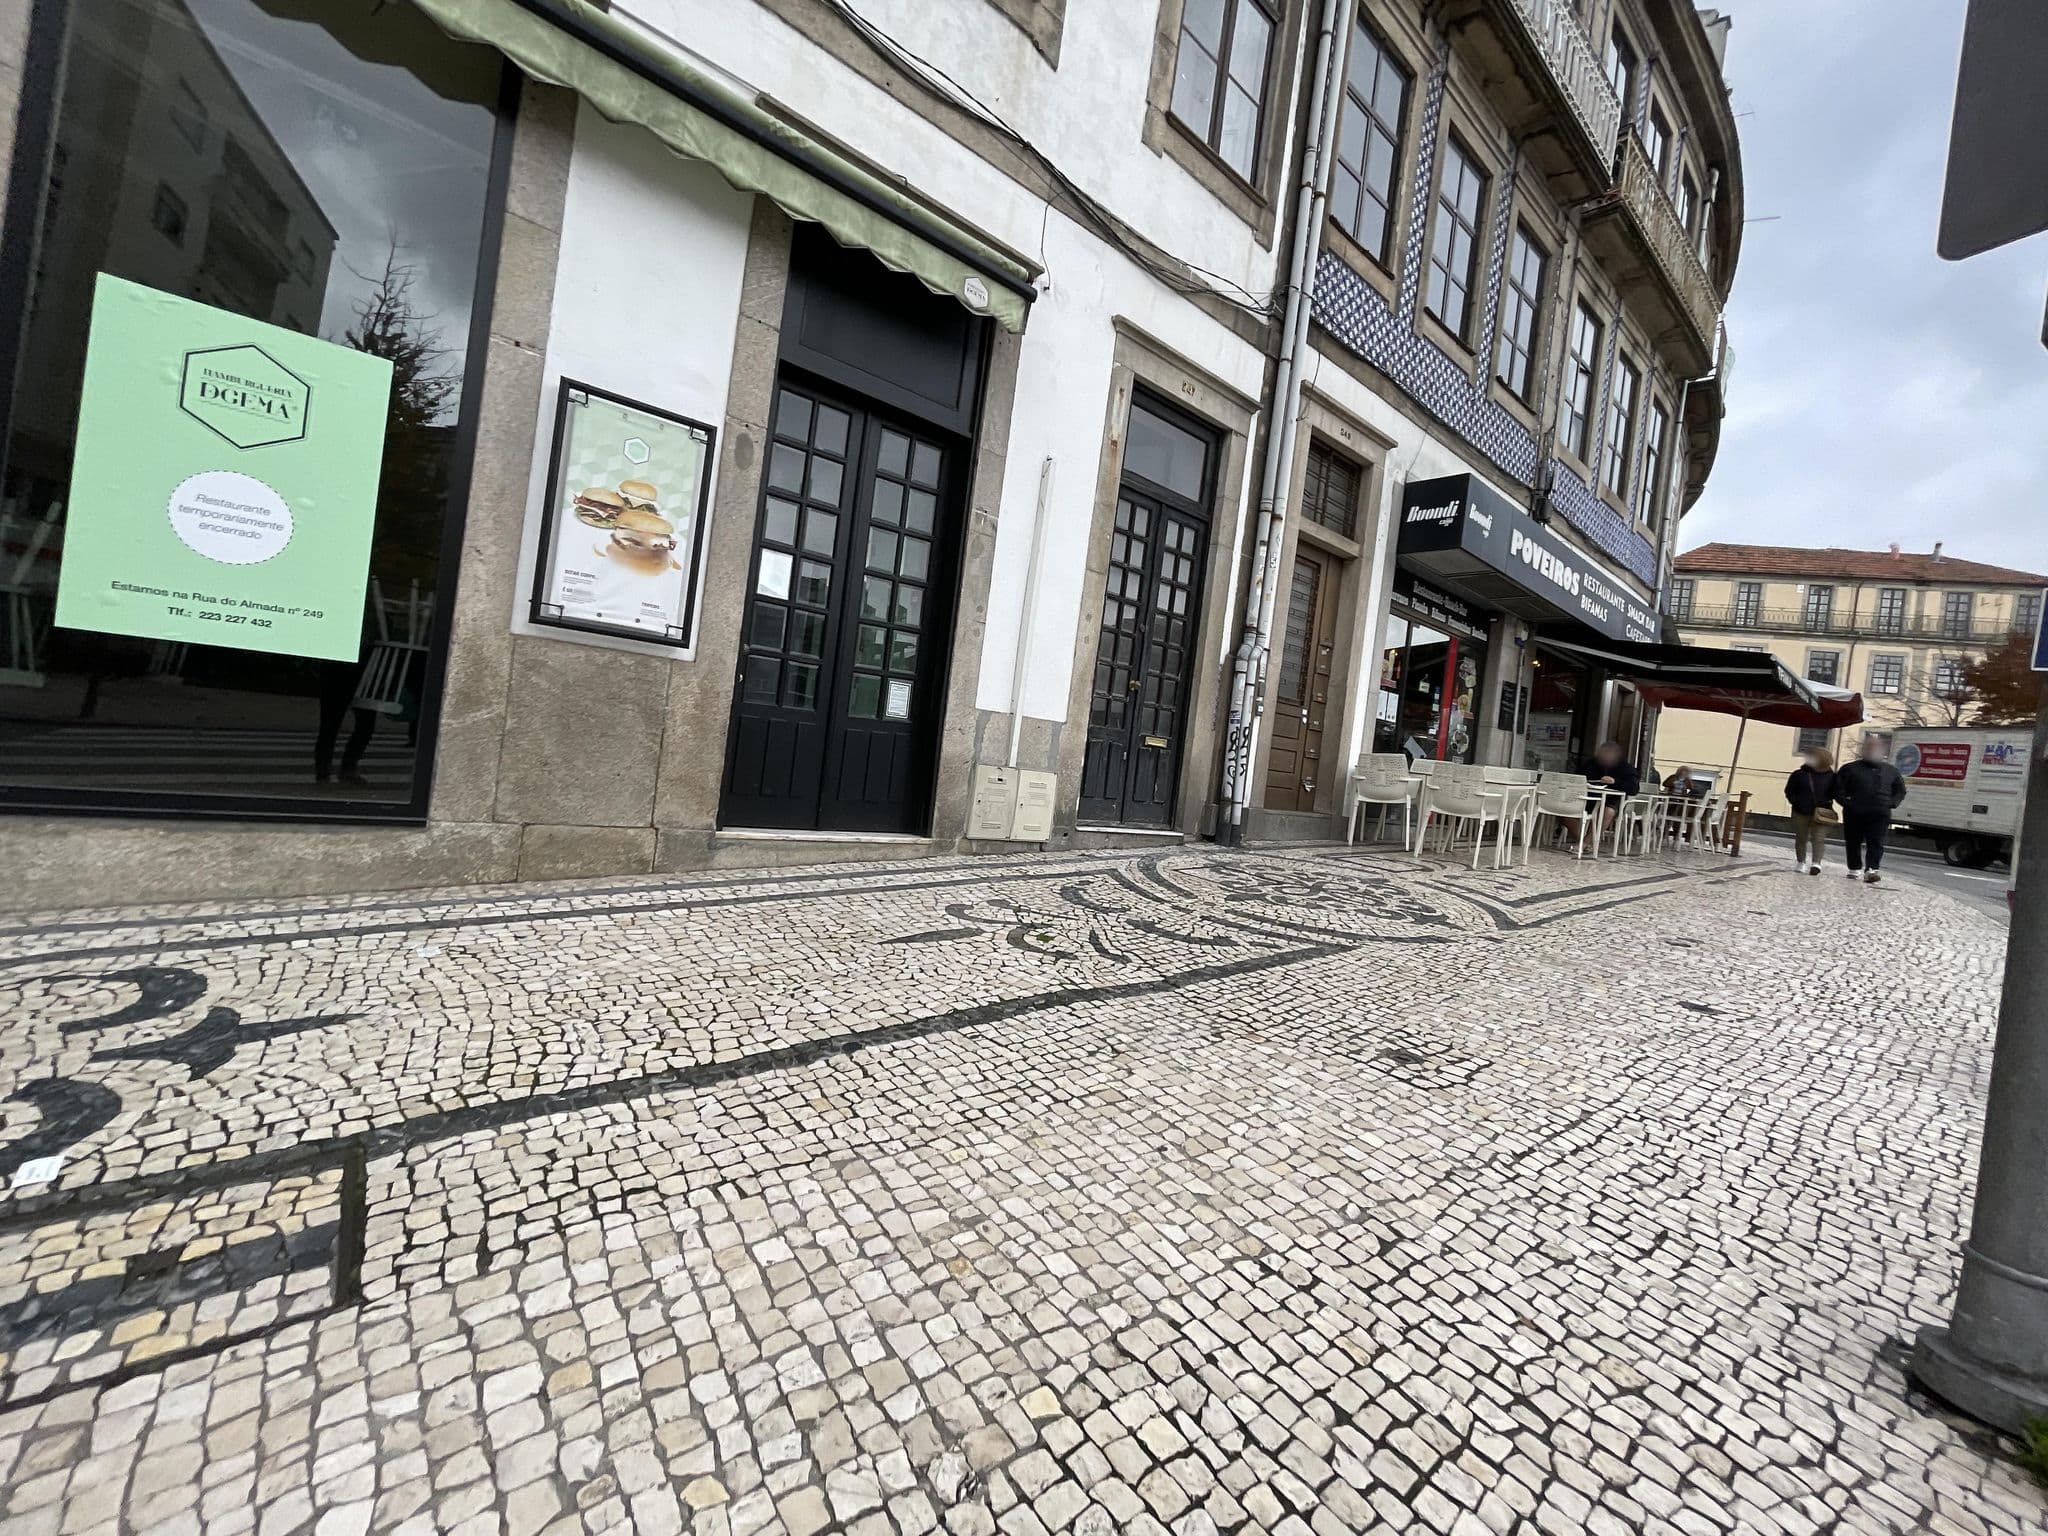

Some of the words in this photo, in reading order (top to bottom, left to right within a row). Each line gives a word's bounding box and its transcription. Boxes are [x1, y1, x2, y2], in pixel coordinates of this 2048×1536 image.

[203, 367, 293, 398] HAMBURGUERIA
[178, 503, 285, 531] temporariamente
[194, 493, 272, 516] Restaurante
[1406, 500, 1460, 523] Buondi
[198, 522, 262, 540] encerrado
[1510, 528, 1581, 597] POVEIROS
[111, 580, 169, 598] Estamos
[172, 590, 189, 600] na
[192, 592, 217, 604] Rua
[220, 597, 237, 607] do
[240, 599, 286, 614] Almada
[303, 608, 324, 619] 249
[1580, 594, 1609, 623] BIFANAS
[1583, 572, 1626, 613] RESTAURANTE
[1627, 603, 1646, 627] SNACK
[198, 610, 222, 622] 223
[225, 613, 247, 625] 227
[250, 618, 273, 629] 432
